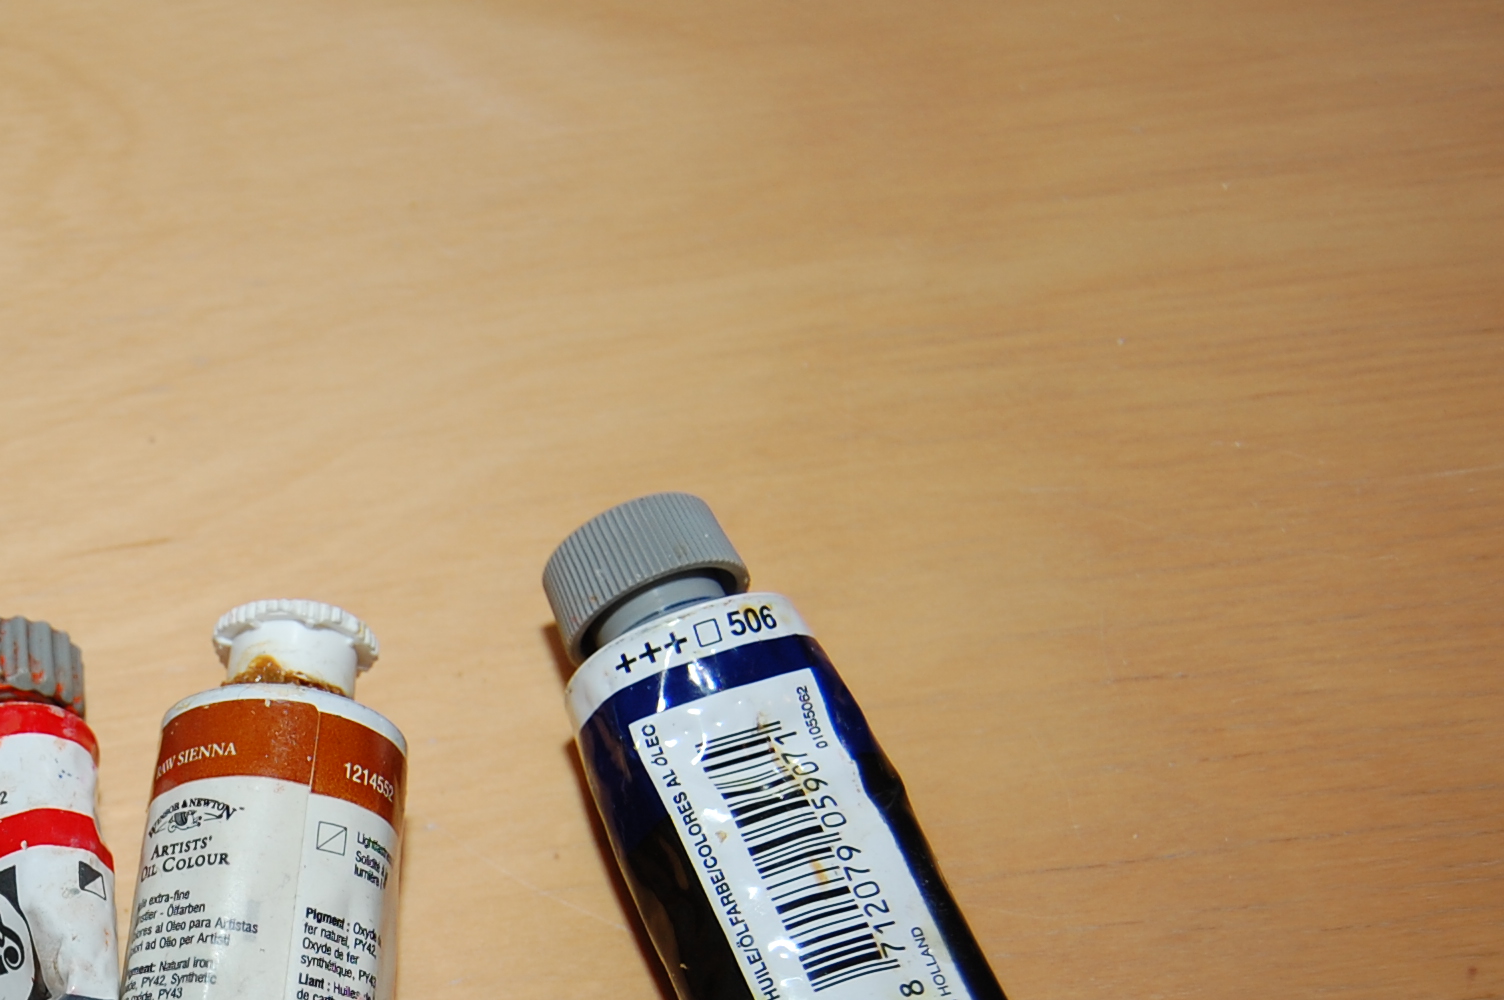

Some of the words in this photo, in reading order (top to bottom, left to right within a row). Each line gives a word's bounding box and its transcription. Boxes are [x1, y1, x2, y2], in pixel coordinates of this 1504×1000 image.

[728, 605, 777, 637] 506
[796, 685, 828, 750] 01055062
[177, 742, 237, 766] SIENNA
[344, 762, 394, 802] 1214552
[659, 768, 682, 788] AL
[775, 731, 847, 829] 059071
[0, 790, 9, 806] 2
[149, 889, 190, 906] extra-fine
[836, 845, 906, 960] 712079
[155, 920, 163, 934] al
[189, 918, 212, 932] para
[214, 917, 259, 934] Artistas
[305, 907, 345, 930] Pigment
[304, 922, 318, 935] fer
[145, 939, 157, 951] ad
[179, 935, 195, 948] per
[302, 937, 331, 956] Oxyde
[334, 948, 344, 960] de
[346, 951, 360, 965] fer
[158, 957, 190, 973] Natural
[910, 926, 952, 998] HOLLAND
[170, 973, 217, 986] Synthetic
[899, 979, 925, 998] 8
[157, 987, 184, 1000] PY43
[296, 988, 310, 1000] de
